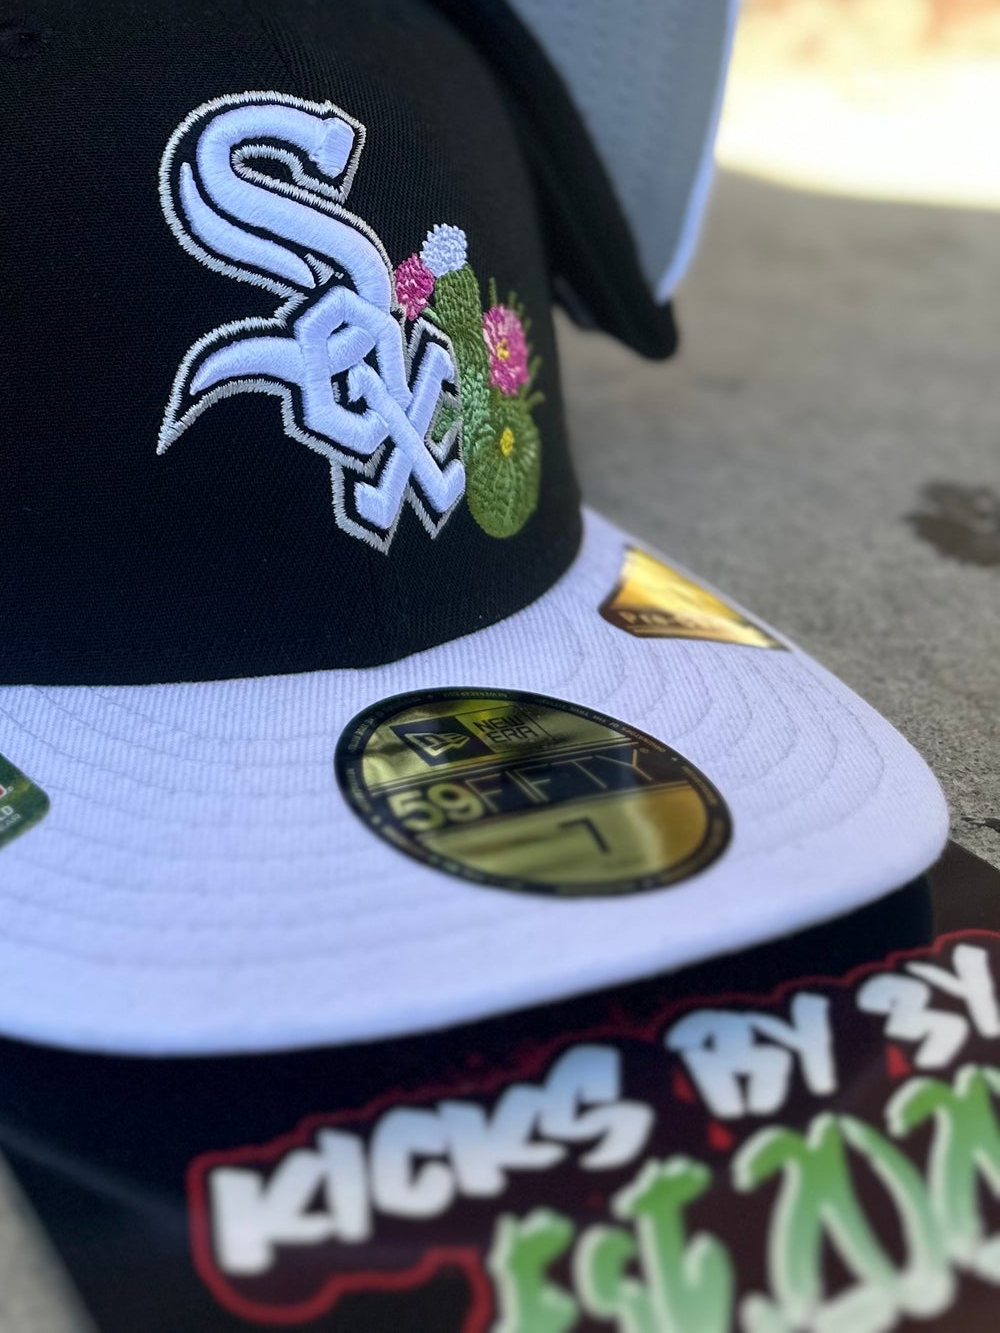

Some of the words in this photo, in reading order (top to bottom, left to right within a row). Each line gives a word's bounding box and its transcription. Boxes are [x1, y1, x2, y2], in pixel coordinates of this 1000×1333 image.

[473, 715, 525, 734] NEW
[487, 726, 540, 748] ERA
[557, 816, 610, 855] 7
[208, 1043, 656, 1275] KICKS
